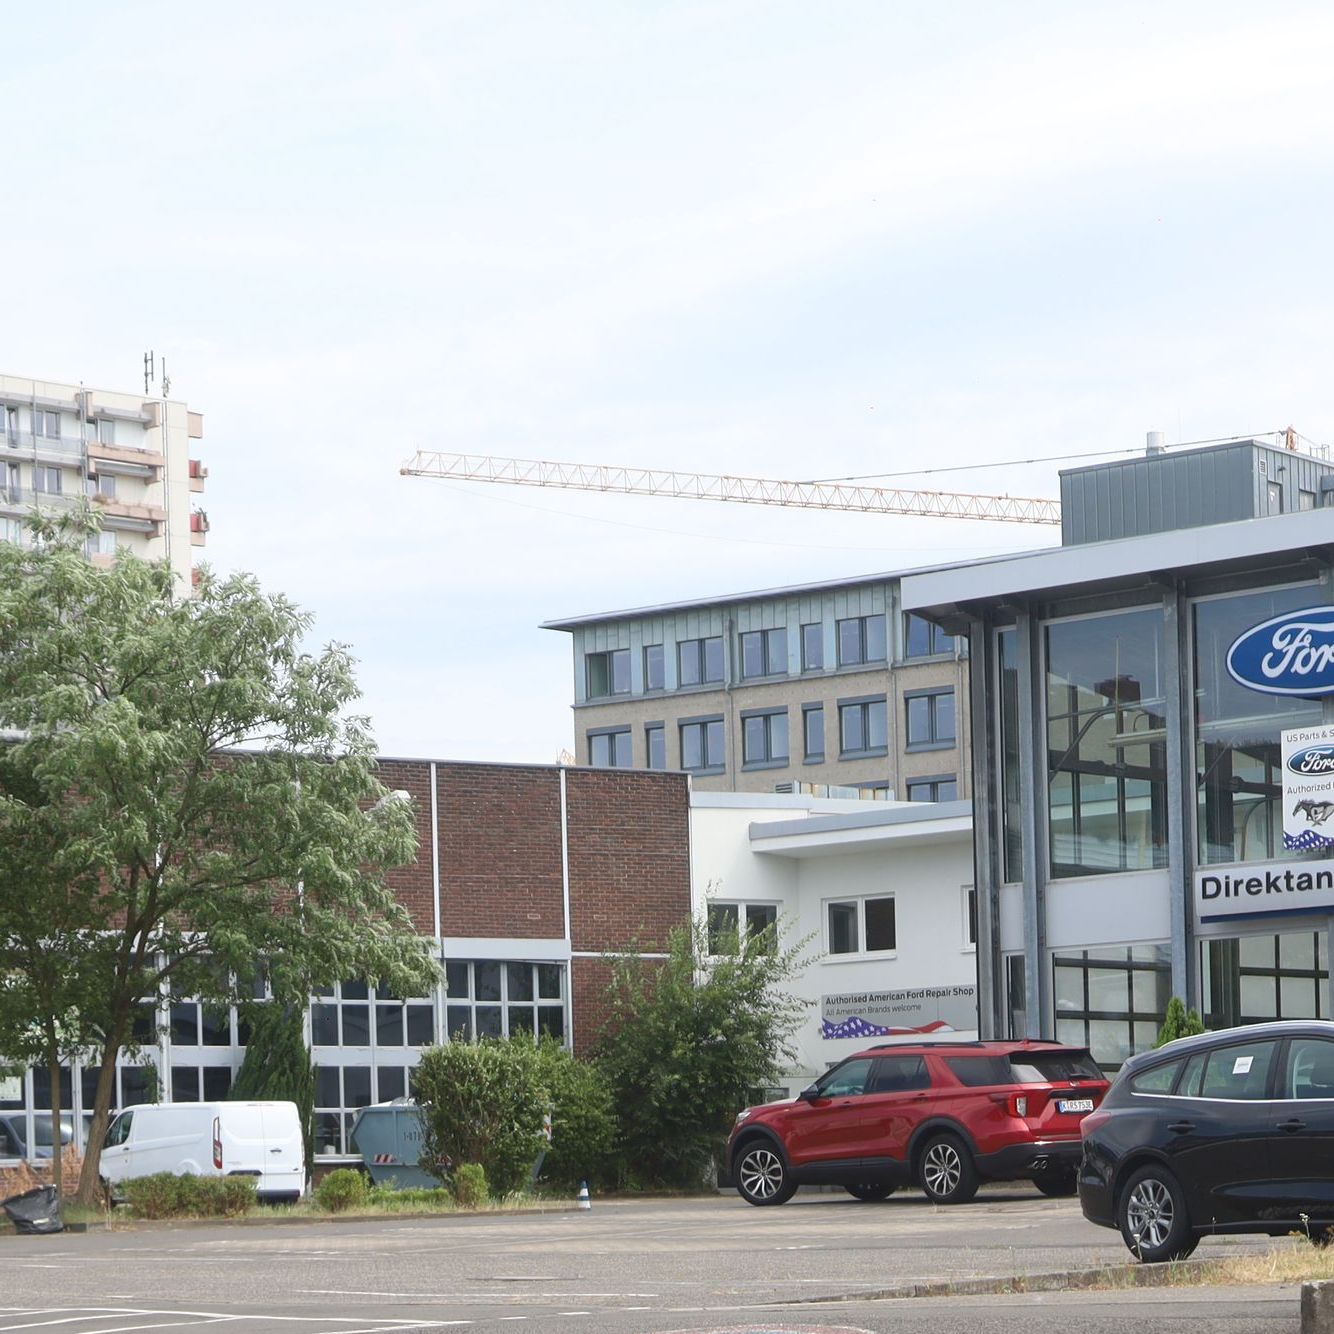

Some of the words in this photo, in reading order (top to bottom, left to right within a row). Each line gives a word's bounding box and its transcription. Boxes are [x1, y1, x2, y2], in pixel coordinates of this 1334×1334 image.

[1286, 734, 1298, 743] US
[1299, 732, 1320, 741] Parts
[1322, 730, 1328, 739] &
[1287, 781, 1332, 794] Authorized
[825, 994, 867, 1006] Authorised
[868, 991, 906, 1003] American
[906, 990, 925, 999] Ford
[925, 988, 952, 1000] Repair
[953, 986, 974, 997] Shop
[825, 1007, 835, 1017] All
[836, 1006, 867, 1016] American
[867, 1004, 891, 1014] Brands
[891, 1003, 922, 1012] welcome
